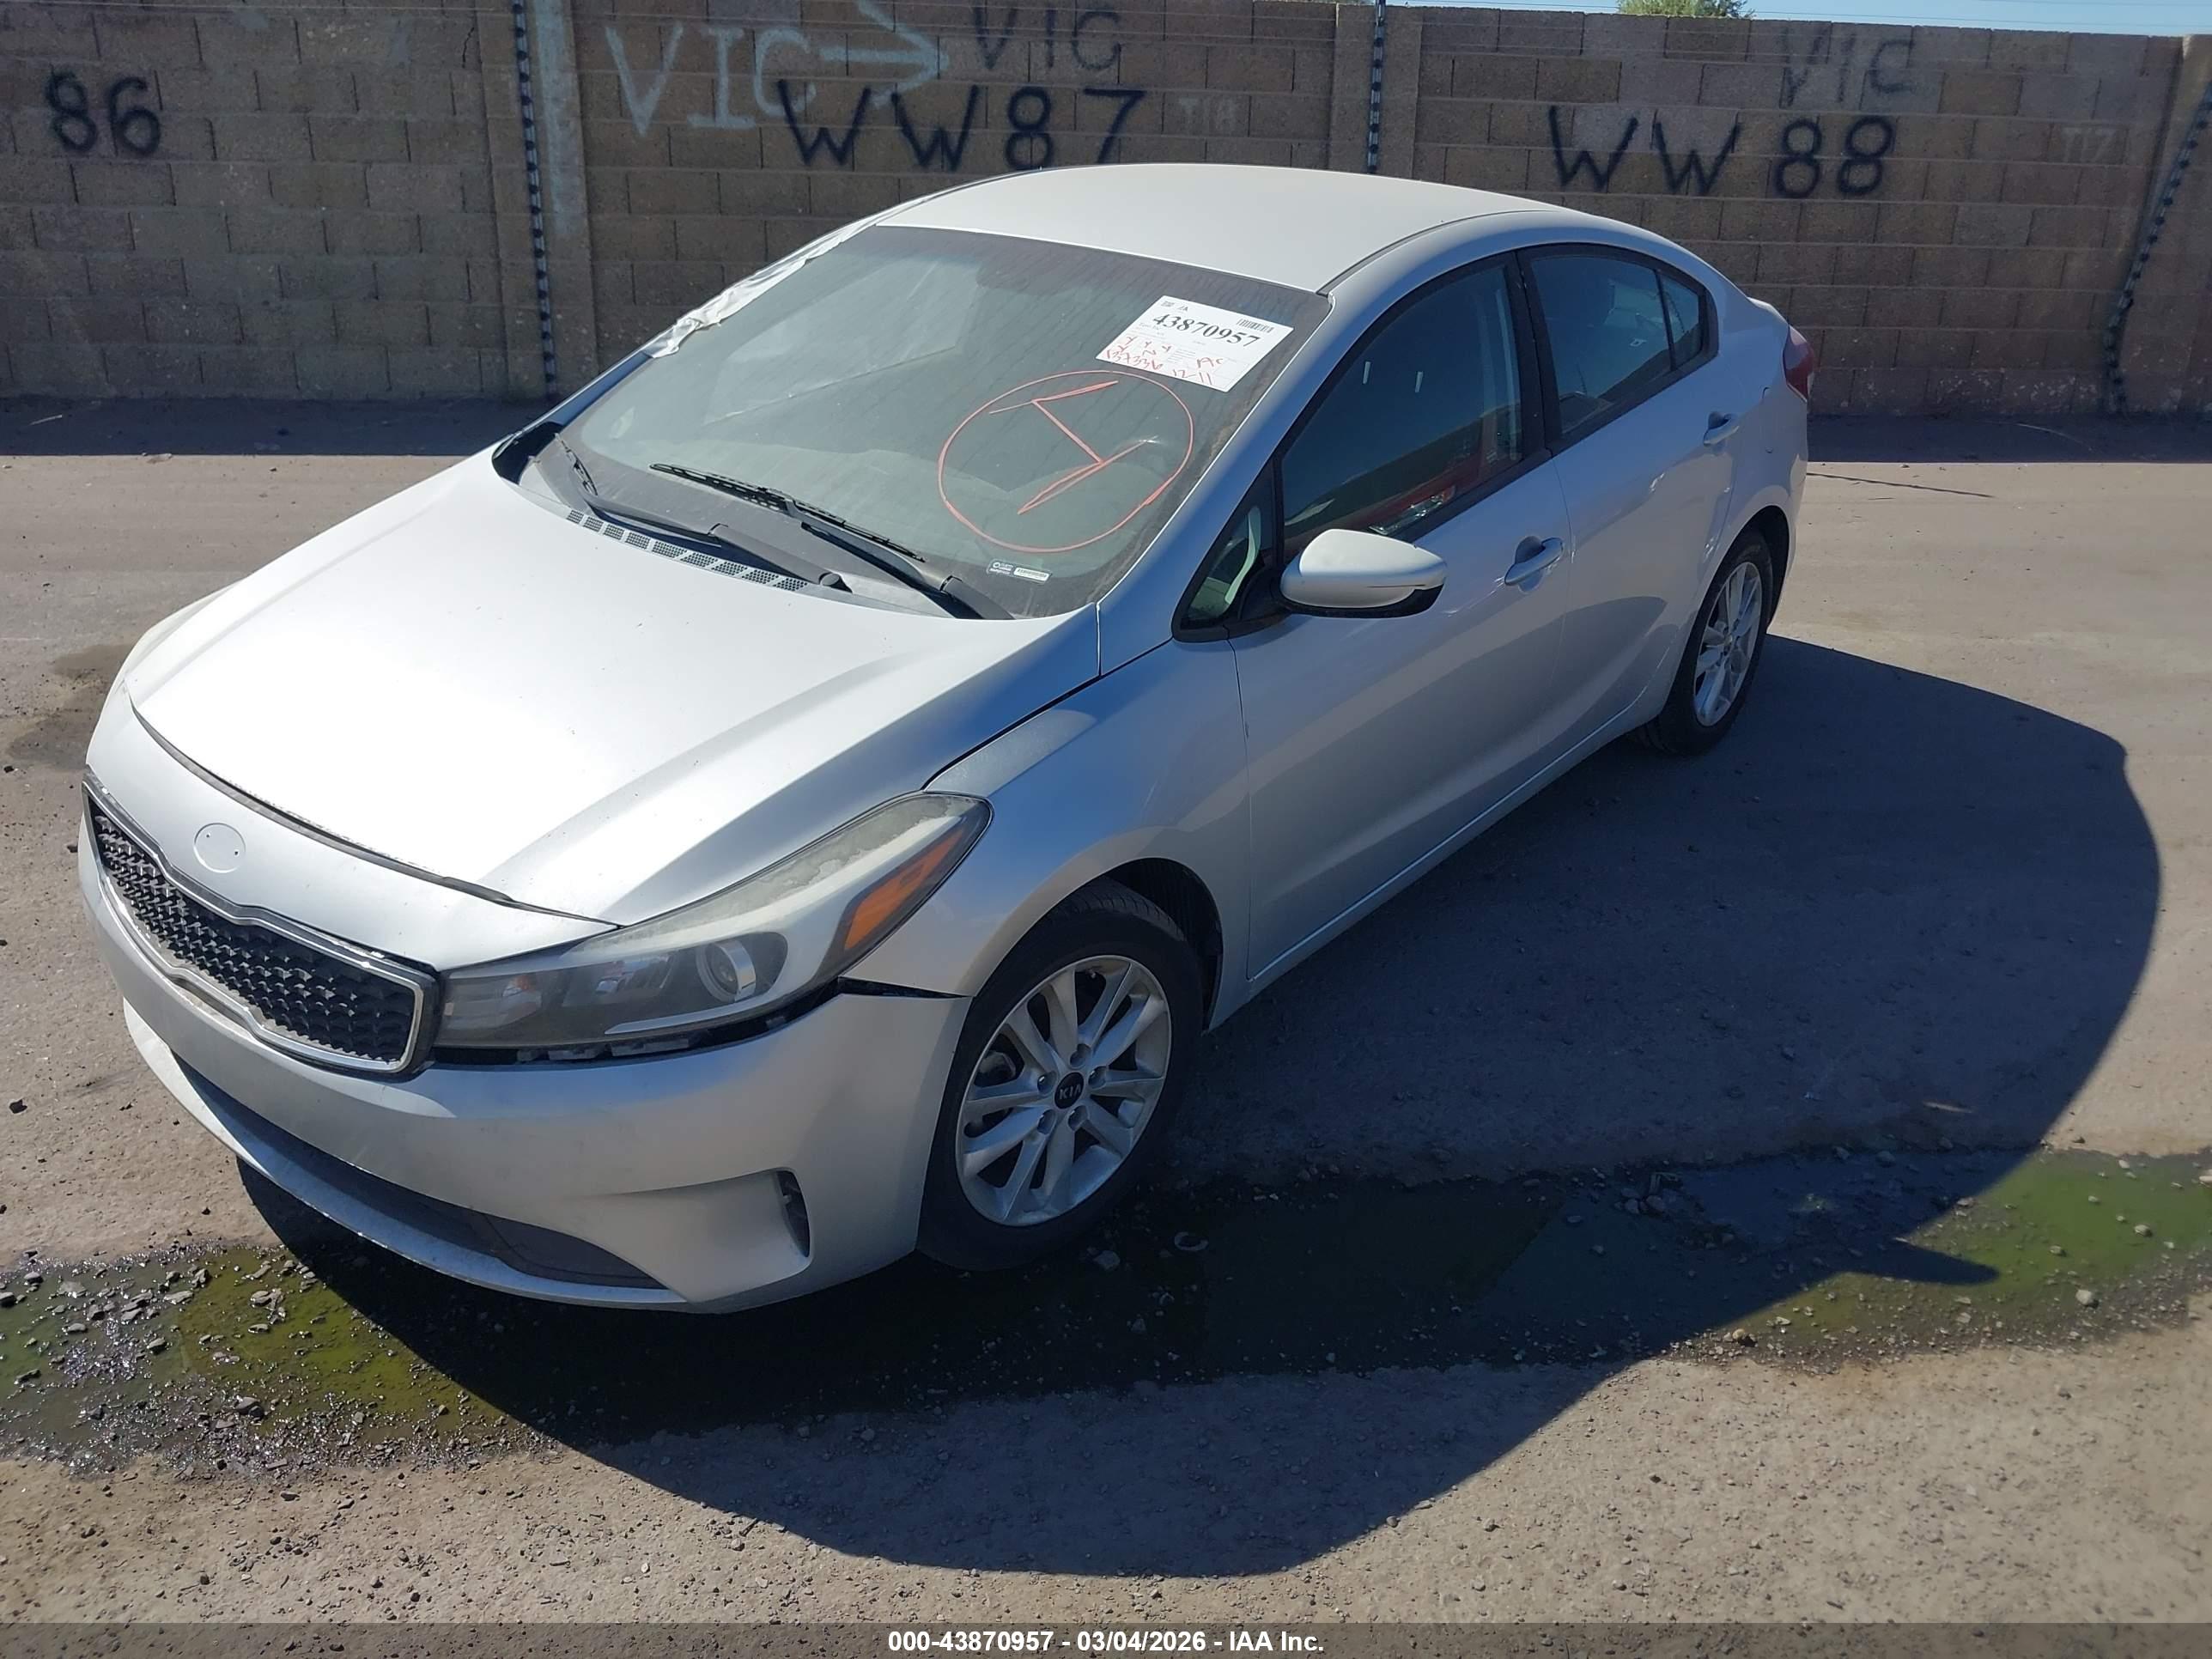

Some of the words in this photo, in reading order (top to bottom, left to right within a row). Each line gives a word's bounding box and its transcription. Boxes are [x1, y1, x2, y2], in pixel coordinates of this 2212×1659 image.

[972, 5, 1121, 70] VIC
[1778, 26, 1915, 107] VIC
[46, 70, 161, 156] 86
[605, 23, 816, 137] VIC
[1152, 313, 1261, 348] 43870957
[1059, 1083, 1081, 1100] KIA
